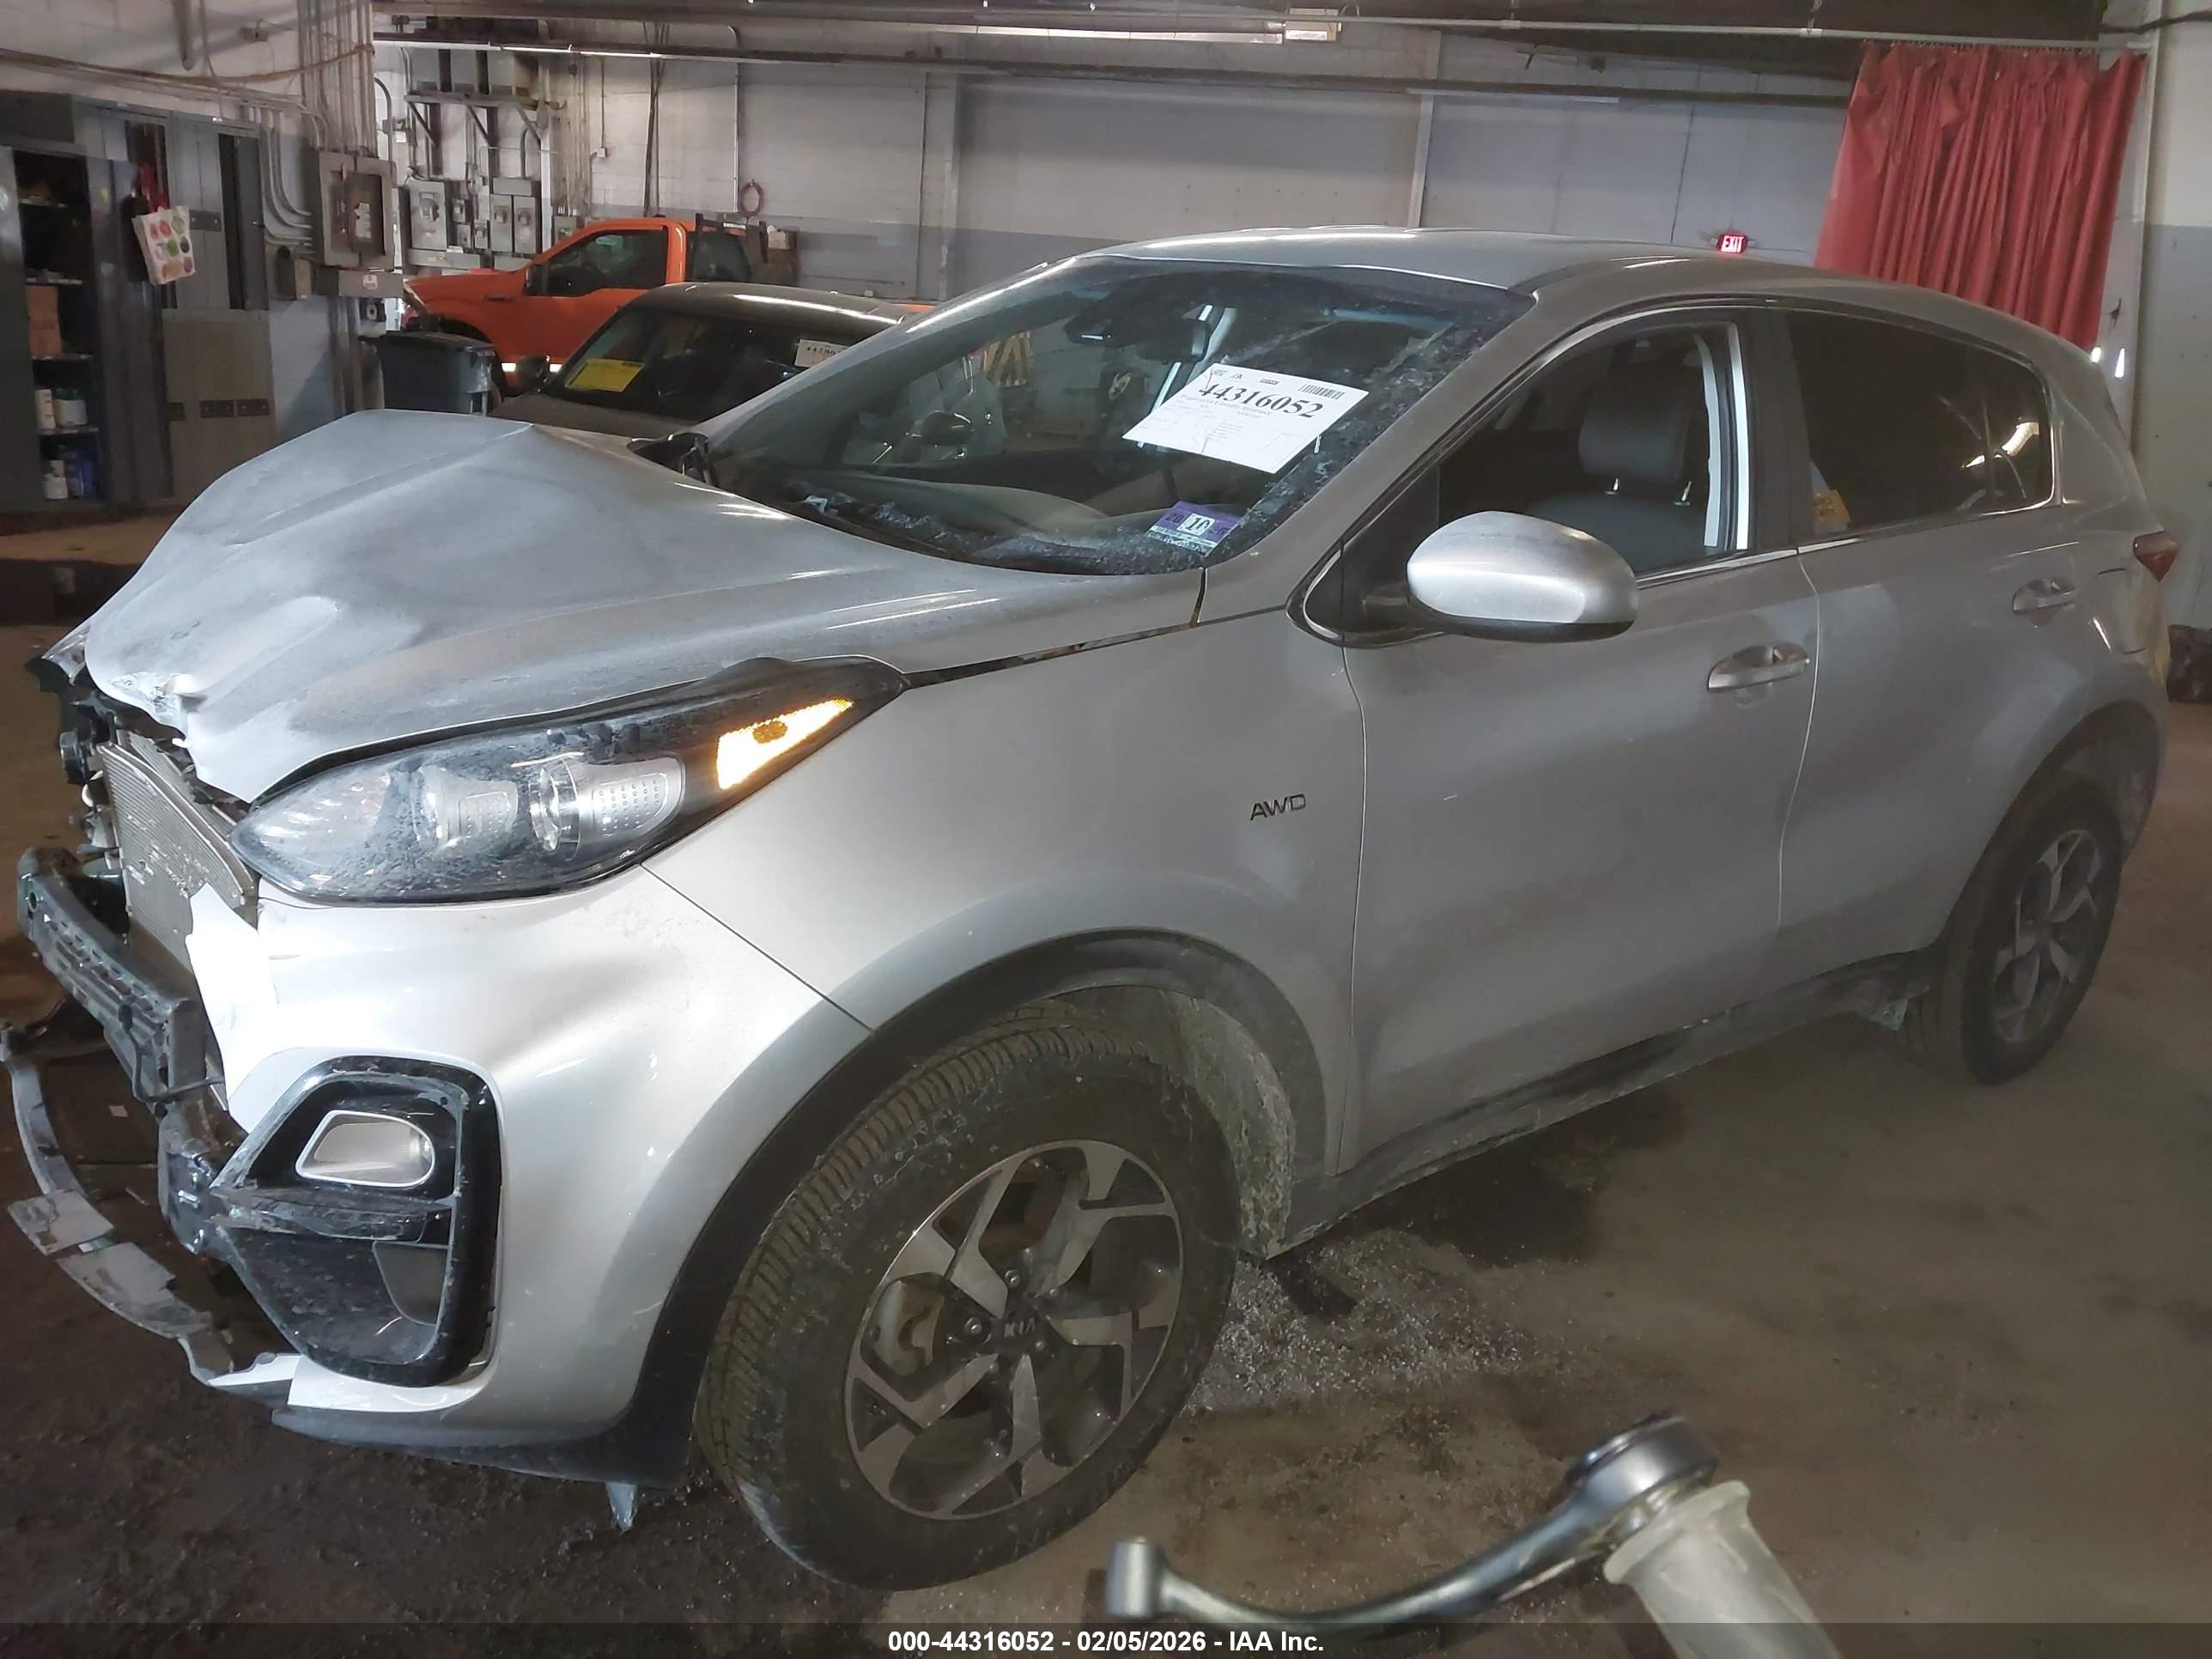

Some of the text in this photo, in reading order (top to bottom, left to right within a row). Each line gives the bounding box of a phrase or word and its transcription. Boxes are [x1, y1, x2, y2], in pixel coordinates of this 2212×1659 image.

[1720, 234, 1745, 252] EXIT
[1198, 383, 1323, 419] 44316052
[1250, 793, 1307, 821] AWD
[1003, 1318, 1036, 1338] KIA
